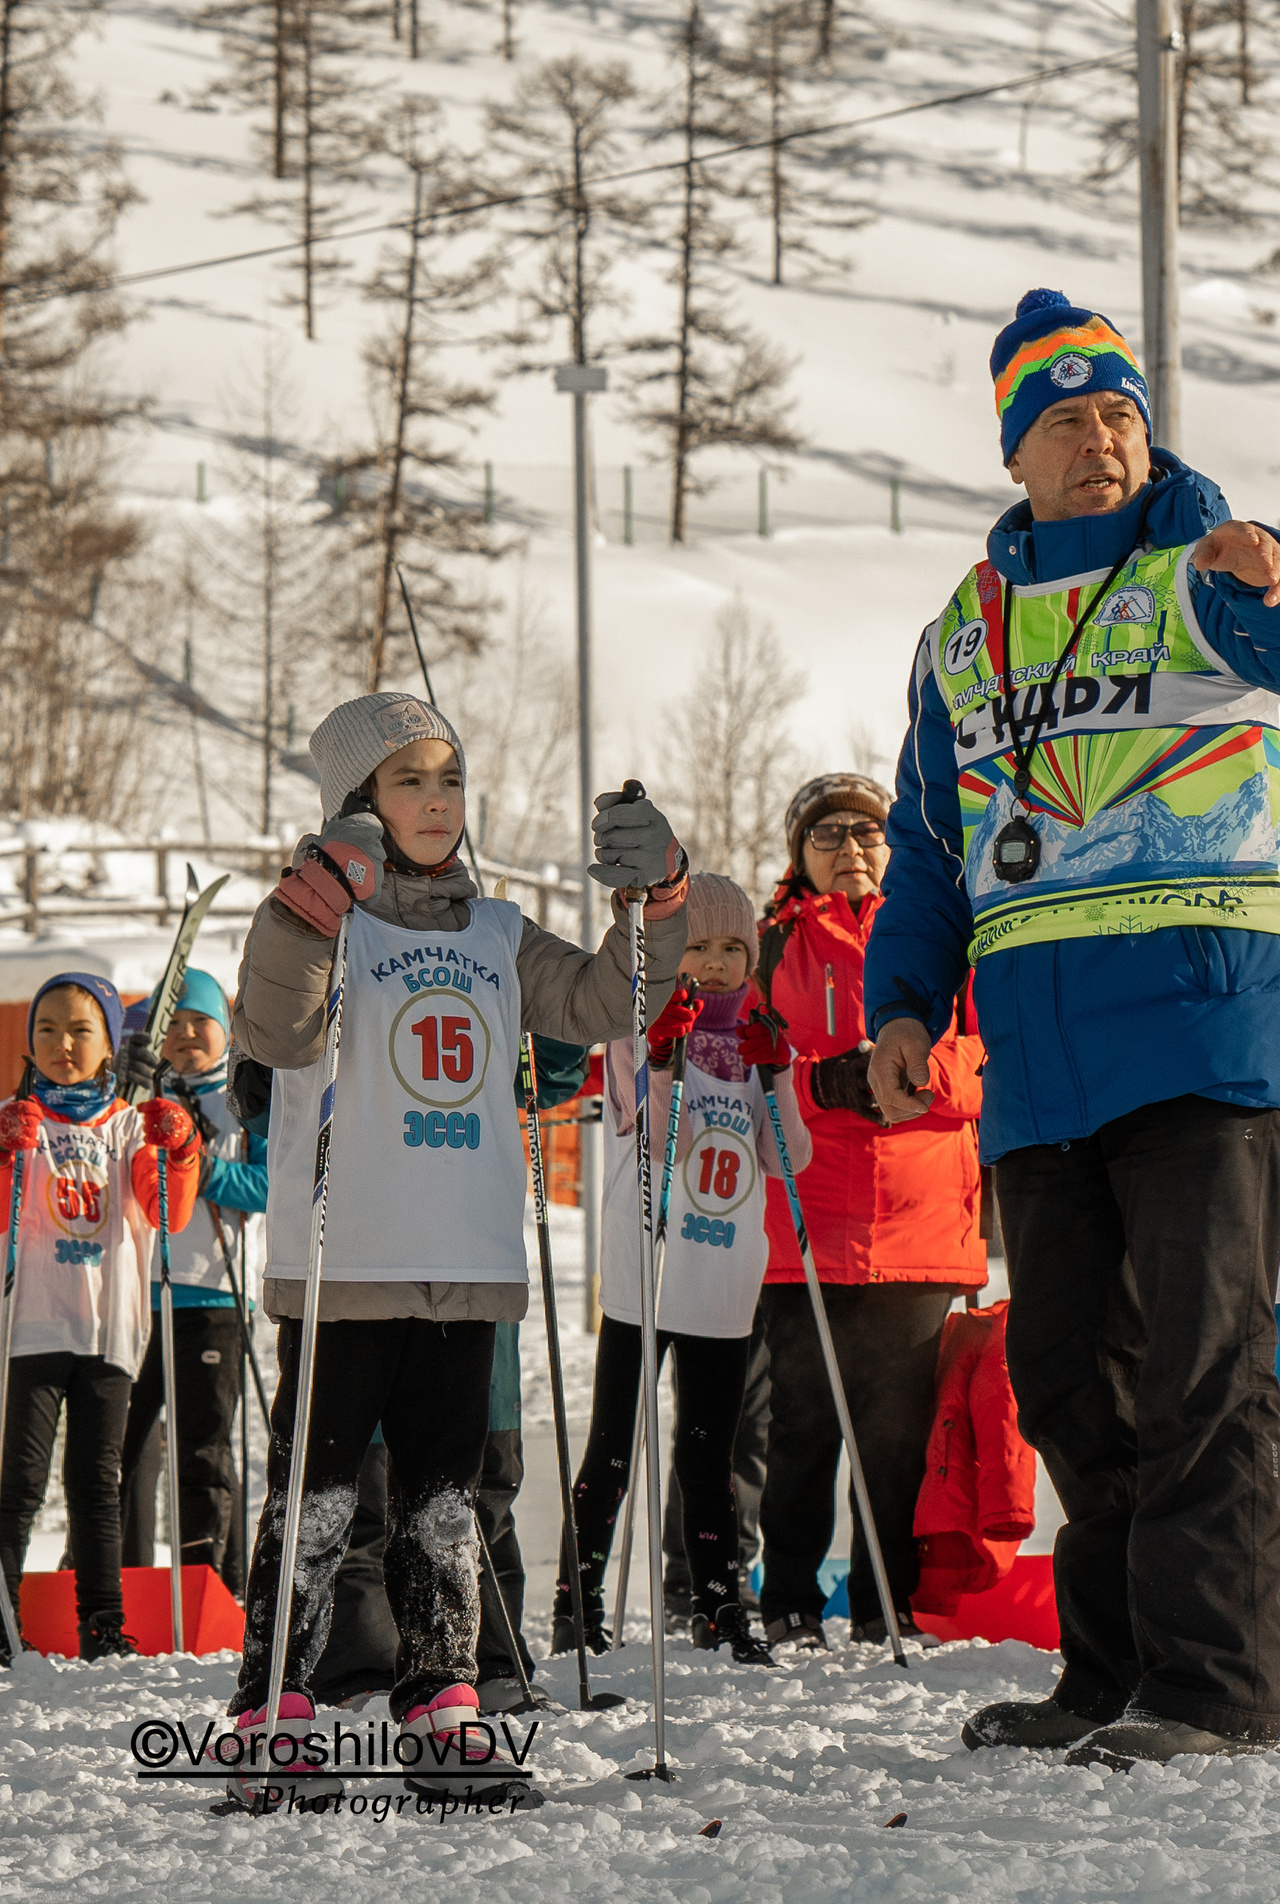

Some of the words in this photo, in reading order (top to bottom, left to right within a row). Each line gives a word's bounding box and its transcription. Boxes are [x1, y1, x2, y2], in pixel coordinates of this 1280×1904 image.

[949, 628, 981, 667] 19
[1091, 642, 1171, 668] КРАЙ
[370, 946, 500, 991] КАМЧАТКА
[402, 966, 473, 994] БСОШ
[411, 1015, 474, 1084] 15
[403, 1110, 480, 1150] ЭССО
[699, 1146, 741, 1200] 18
[57, 1177, 101, 1223] 56
